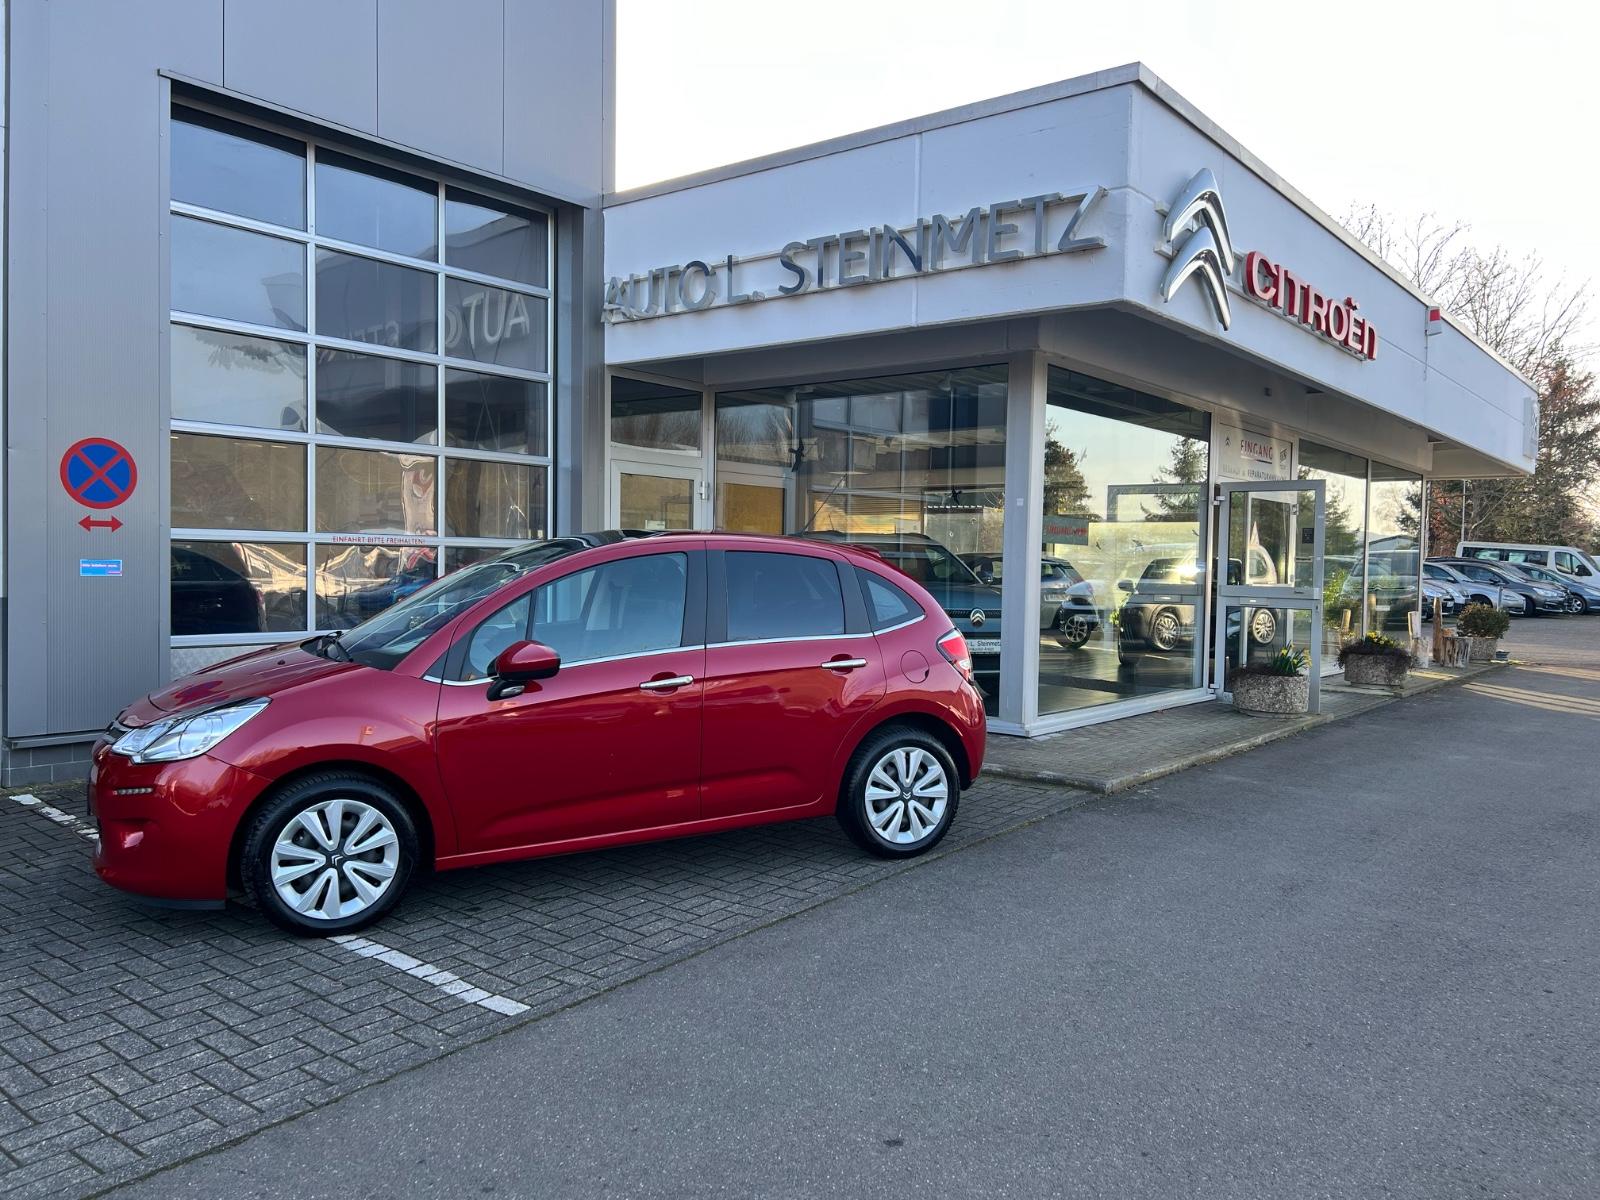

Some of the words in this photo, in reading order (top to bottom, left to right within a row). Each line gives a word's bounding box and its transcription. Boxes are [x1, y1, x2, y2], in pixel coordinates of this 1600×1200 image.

[602, 260, 717, 326] AUTO
[727, 254, 767, 306] L.
[778, 186, 1107, 295] STEINMETZ
[1240, 440, 1272, 460] EINGANG
